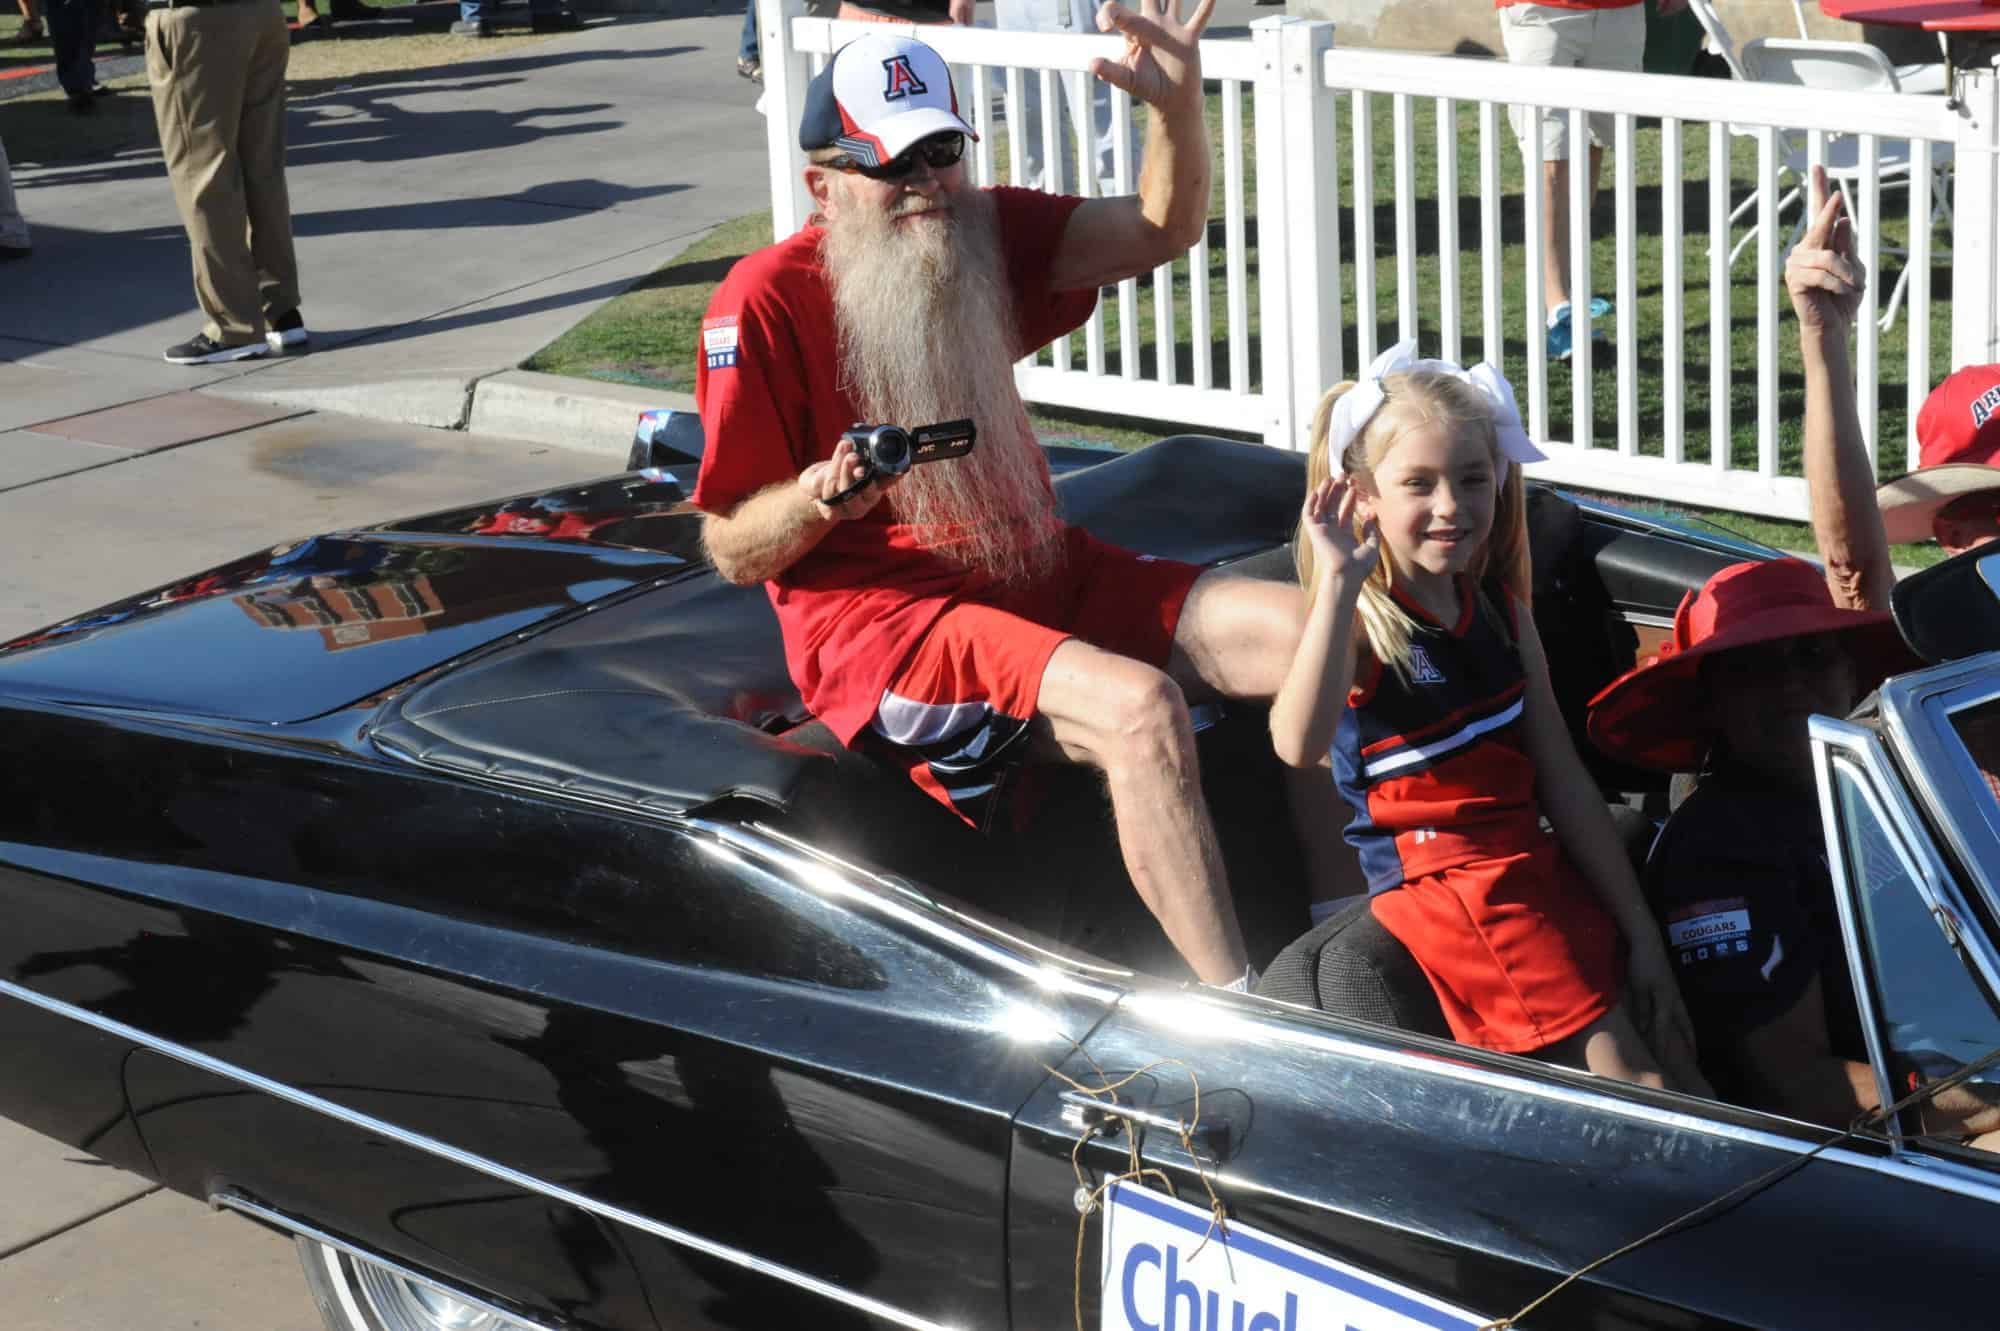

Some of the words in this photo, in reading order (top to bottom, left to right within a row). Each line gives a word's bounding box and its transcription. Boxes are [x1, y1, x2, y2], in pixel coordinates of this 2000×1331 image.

[881, 54, 928, 102] A
[1681, 921, 1737, 940] COUGARS
[1122, 1242, 1298, 1331] Chu
